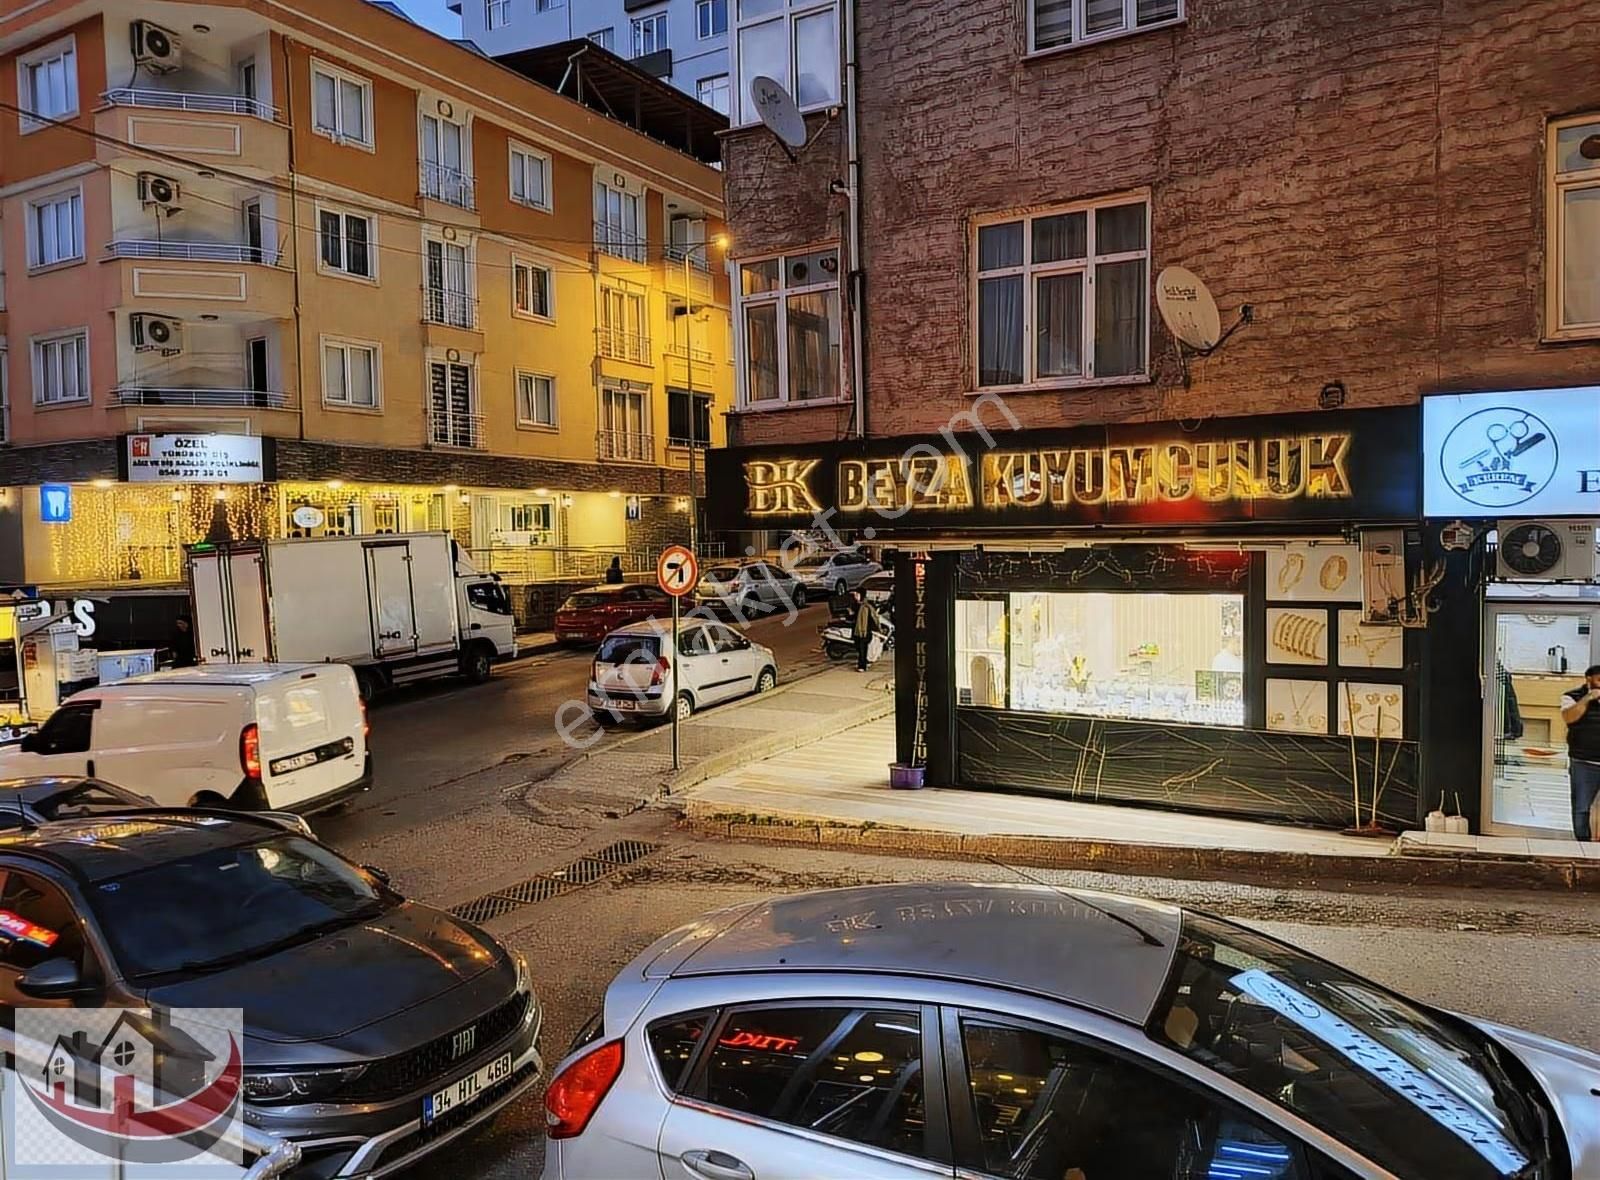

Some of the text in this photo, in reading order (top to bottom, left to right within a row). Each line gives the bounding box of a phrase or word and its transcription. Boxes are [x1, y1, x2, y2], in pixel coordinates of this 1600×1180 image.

[174, 437, 208, 449] ÖZEL
[839, 455, 974, 511] BEYZA
[981, 433, 1352, 506] KUYUMCULUK
[915, 563, 926, 629] BEYZA
[452, 1025, 477, 1059] FIAT
[434, 1090, 451, 1113] 34
[458, 1074, 482, 1101] HTL
